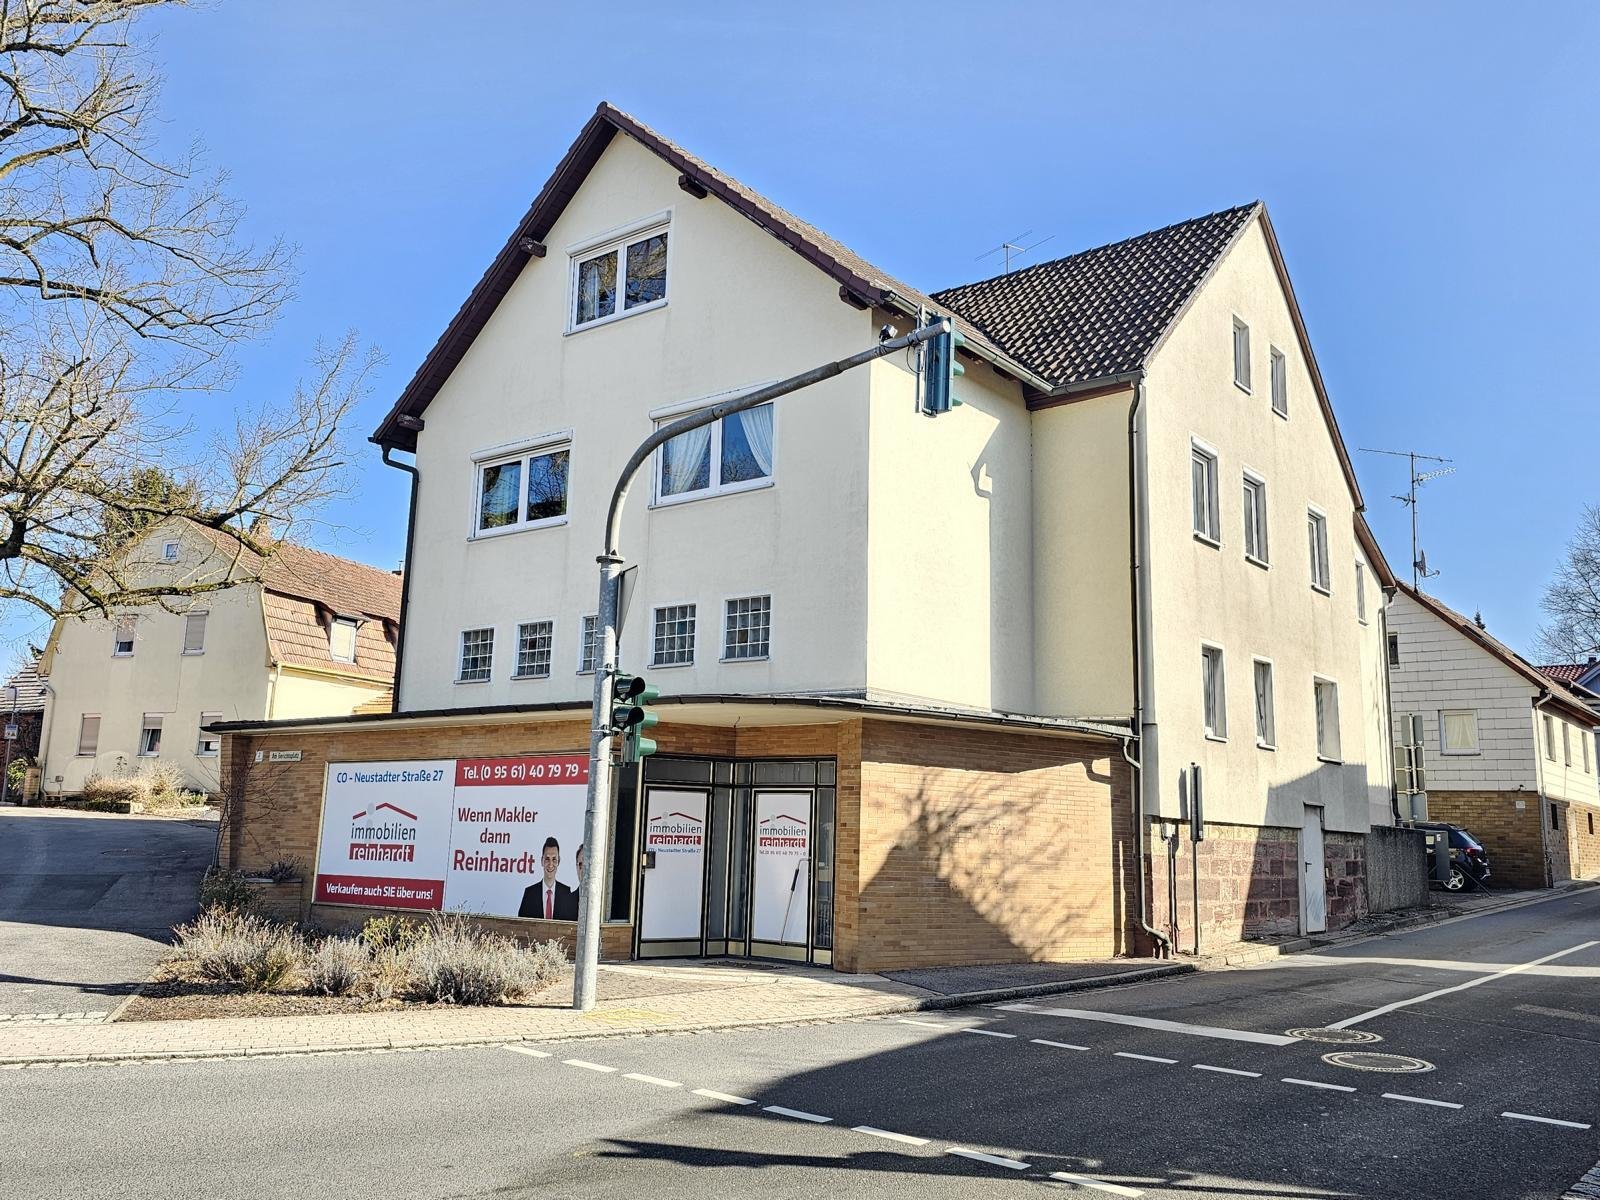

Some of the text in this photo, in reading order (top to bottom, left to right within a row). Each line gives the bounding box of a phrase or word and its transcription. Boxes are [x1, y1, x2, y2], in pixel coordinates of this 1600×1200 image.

[336, 772, 348, 783] CO
[354, 771, 400, 782] Neustadter
[402, 770, 431, 782] Straße
[432, 770, 444, 781] 27
[464, 767, 478, 779] Tel.
[494, 766, 506, 778] 95
[511, 764, 526, 780] 61)
[530, 765, 544, 778] 40
[548, 764, 560, 778] 79
[566, 764, 578, 777] 79
[458, 806, 538, 822] Wenn Makler
[351, 822, 416, 840] immobilien
[480, 828, 510, 844] dann
[650, 822, 702, 834] immobilien
[760, 826, 806, 836] immobilien
[652, 834, 699, 845] reinhardt
[762, 837, 804, 848] reinhardt
[352, 844, 410, 861] reinhardt
[454, 850, 535, 874] Reinhardt
[326, 883, 433, 900] Verkaufen auch SIE über uns!
